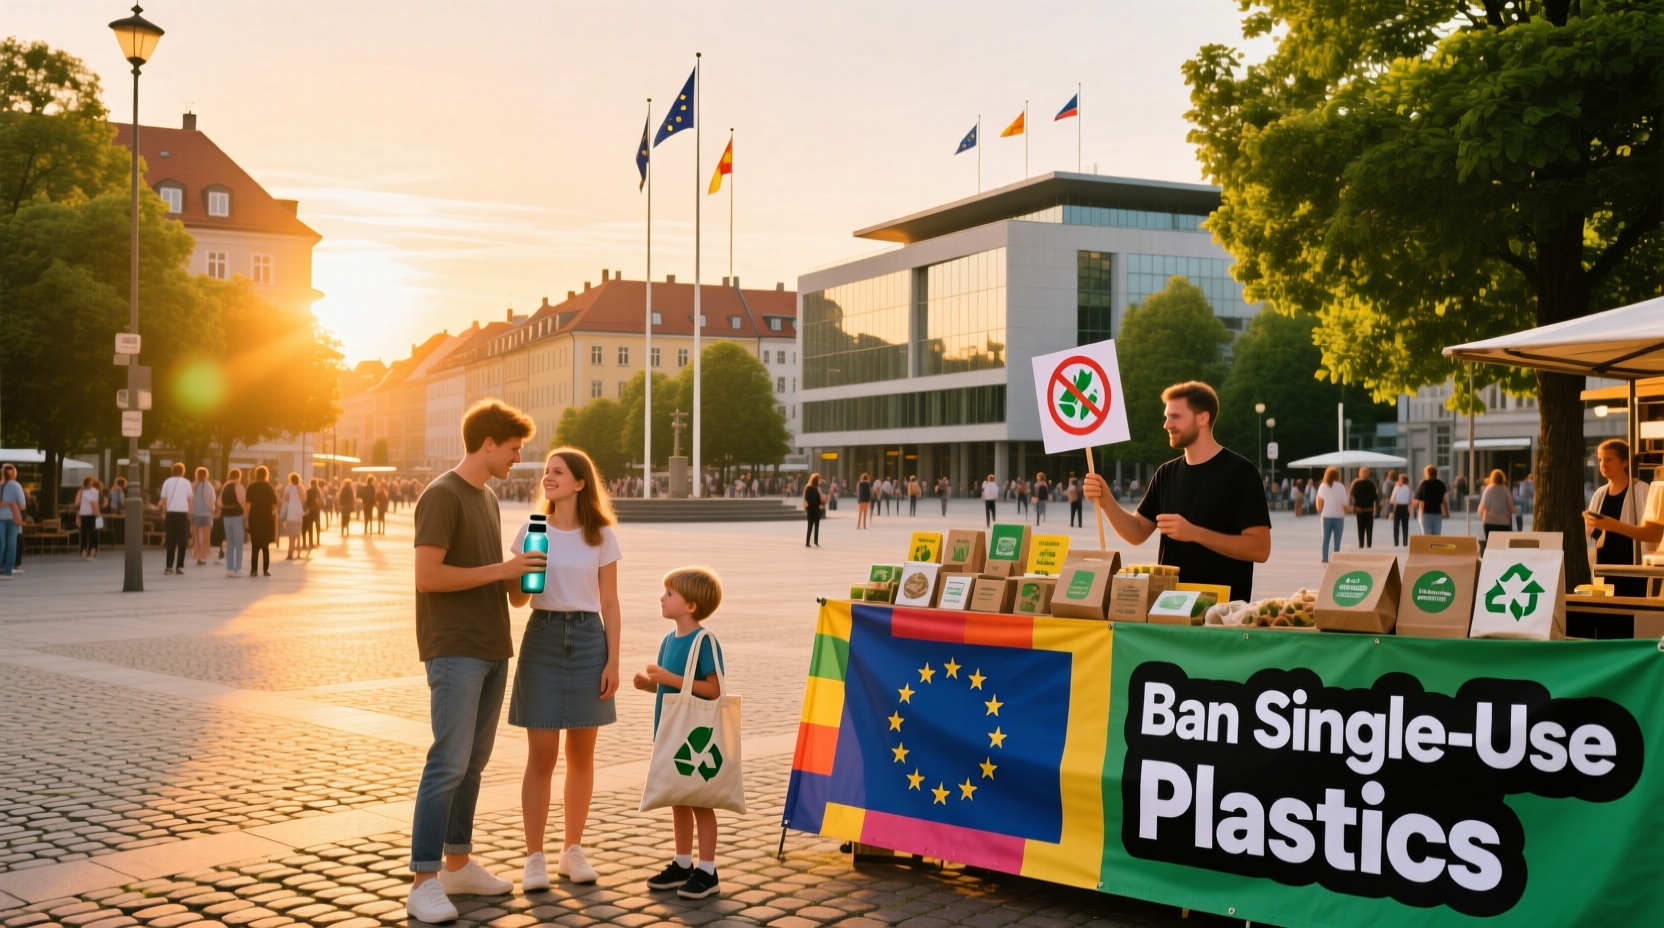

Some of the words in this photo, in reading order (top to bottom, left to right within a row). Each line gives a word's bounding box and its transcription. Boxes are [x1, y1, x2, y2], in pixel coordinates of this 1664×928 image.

[1141, 681, 1240, 744] Ban
[1253, 688, 1617, 776] Single-Use
[1139, 759, 1503, 892] Plastics
